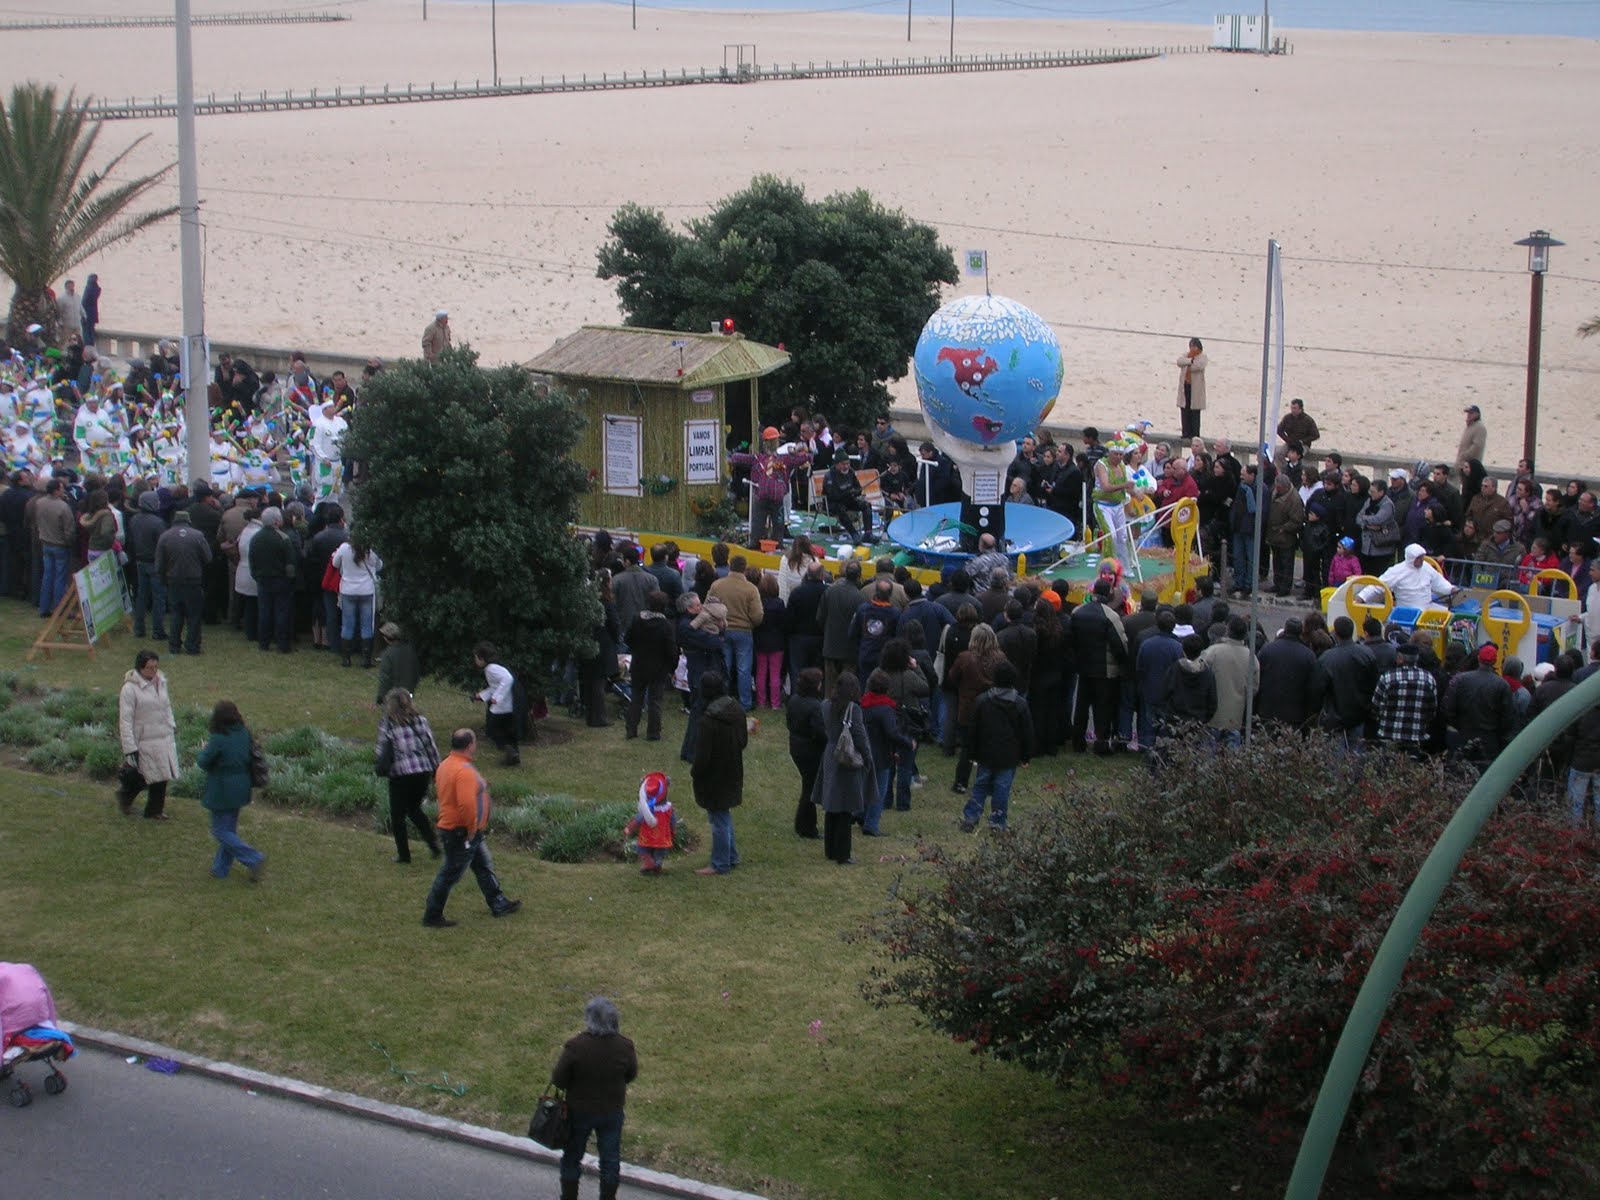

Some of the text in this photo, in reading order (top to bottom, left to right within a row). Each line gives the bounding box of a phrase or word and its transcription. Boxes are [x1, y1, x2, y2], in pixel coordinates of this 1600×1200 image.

[692, 430, 710, 440] VAMOS
[689, 445, 714, 457] LIMPAR
[689, 462, 715, 472] PORTUGAL
